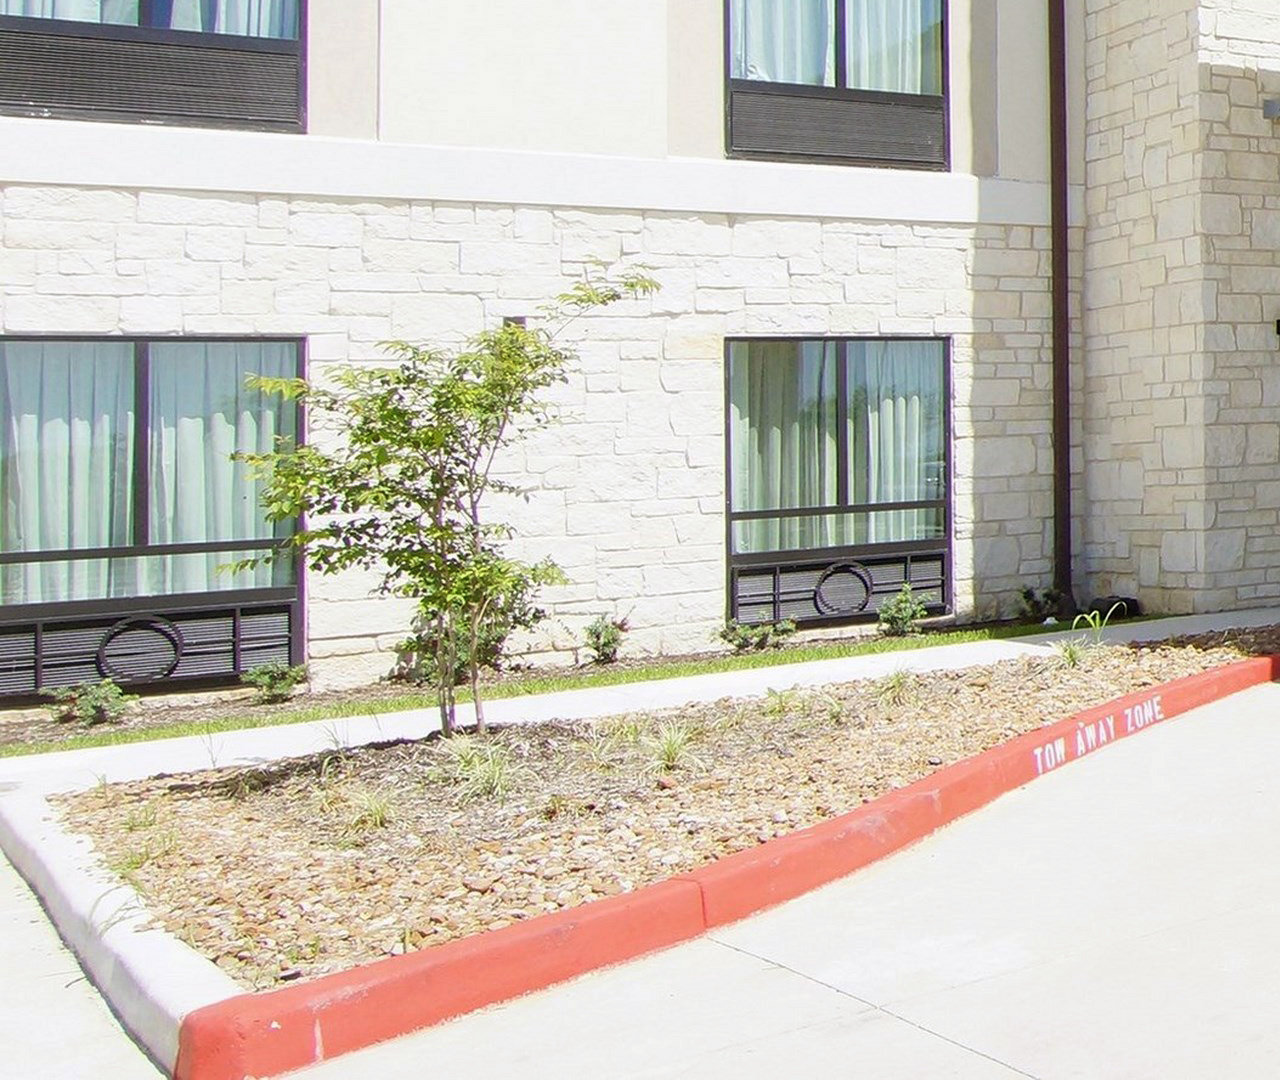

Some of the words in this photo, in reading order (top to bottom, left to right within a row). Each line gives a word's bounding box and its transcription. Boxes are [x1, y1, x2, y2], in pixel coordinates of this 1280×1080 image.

[1033, 737, 1066, 775] TOW
[1075, 715, 1116, 757] AWAY
[1123, 695, 1165, 733] ZONE
